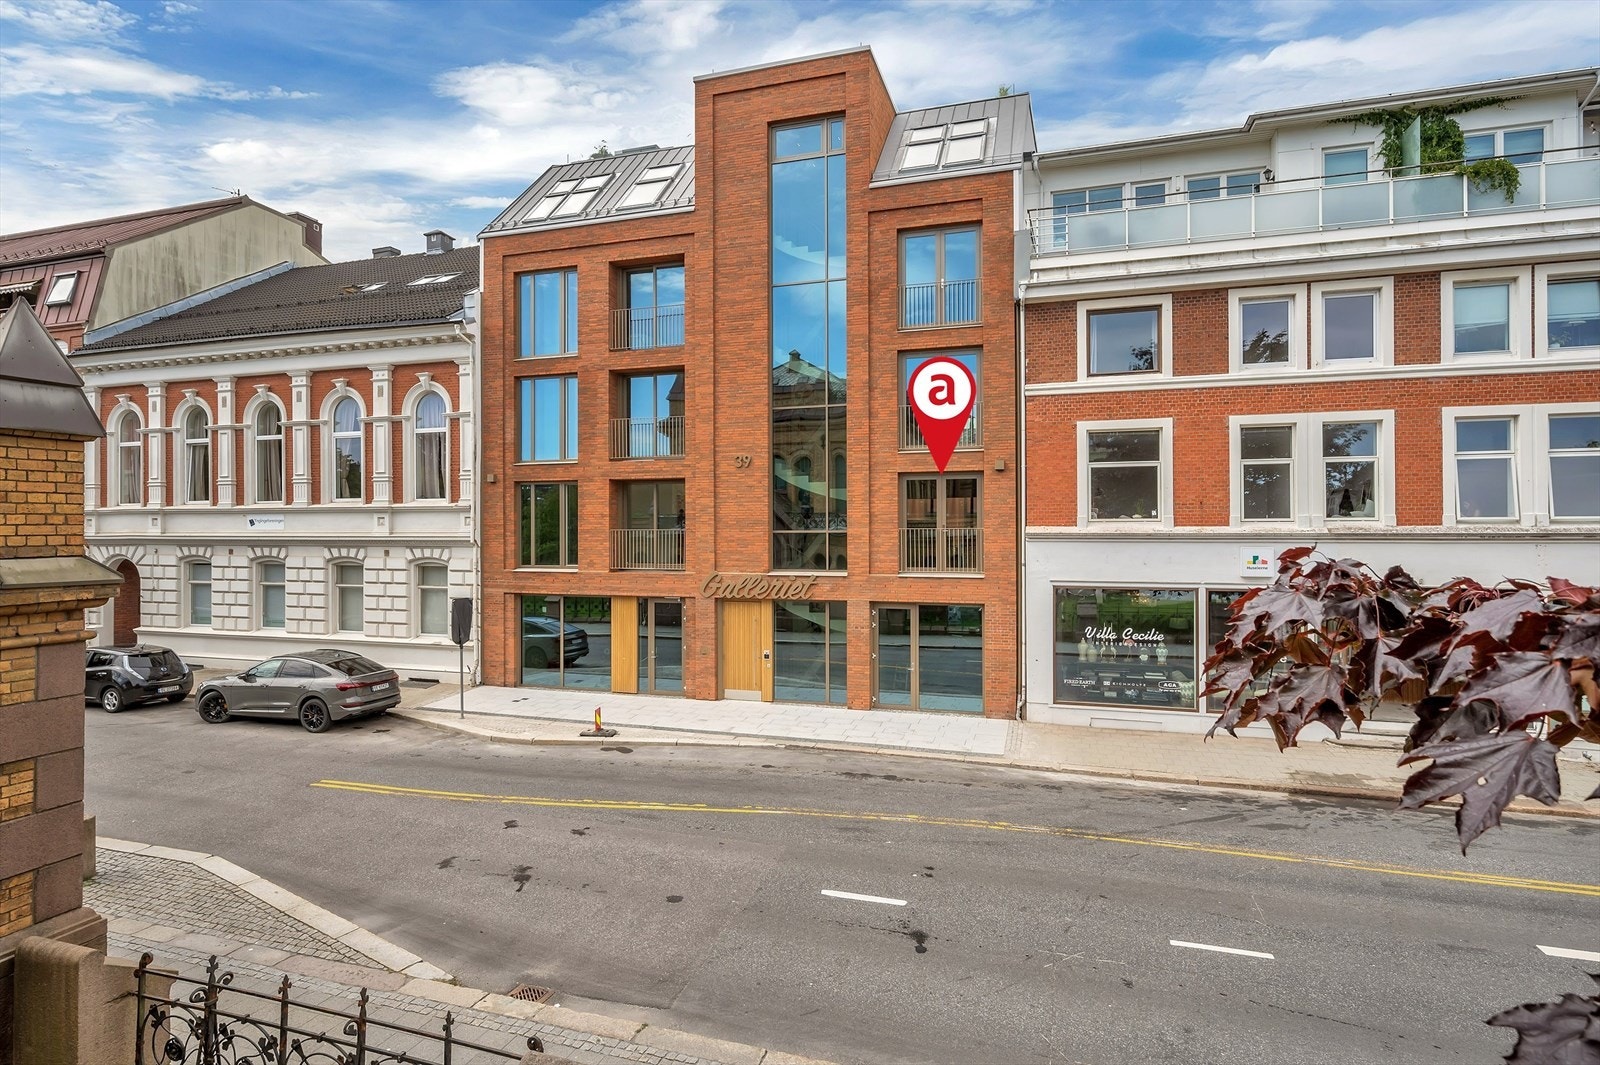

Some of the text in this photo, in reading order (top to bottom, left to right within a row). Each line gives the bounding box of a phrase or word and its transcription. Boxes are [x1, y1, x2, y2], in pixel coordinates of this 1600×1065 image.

[735, 455, 751, 468] 39
[701, 571, 816, 600] Galleriet
[1085, 626, 1165, 641] Villa Cecilie
